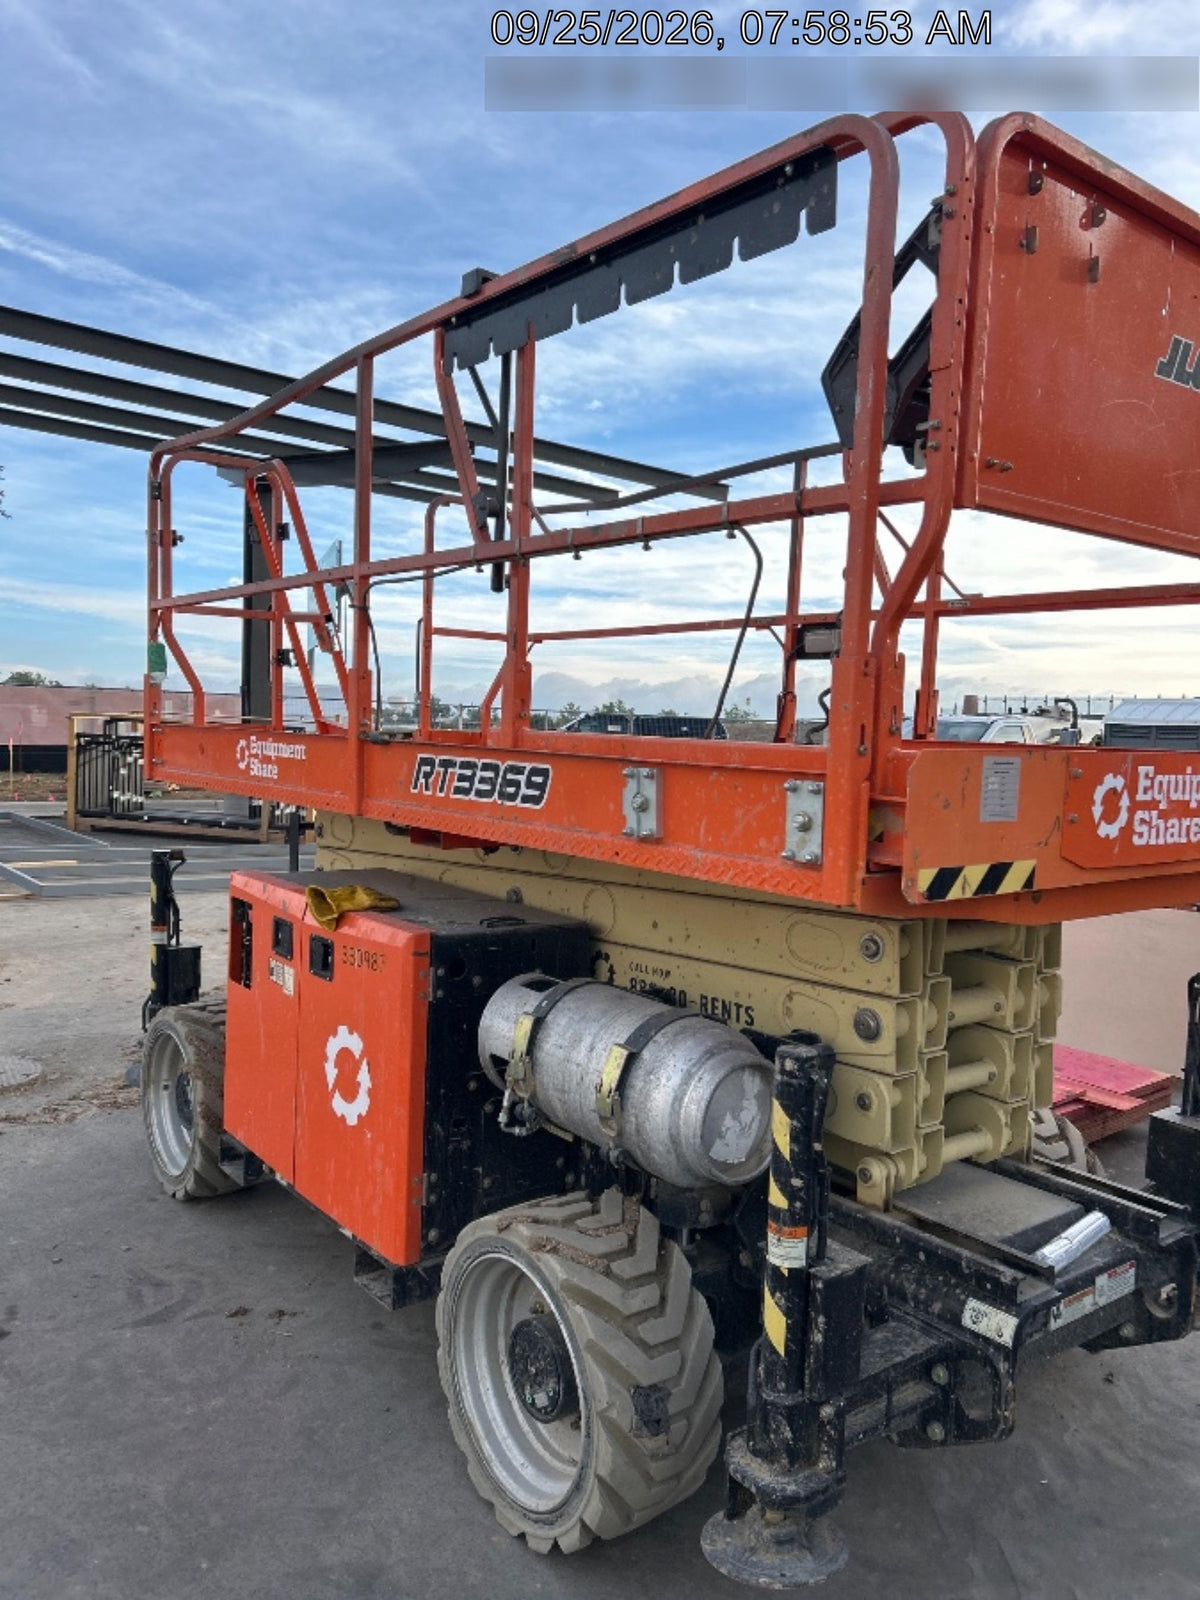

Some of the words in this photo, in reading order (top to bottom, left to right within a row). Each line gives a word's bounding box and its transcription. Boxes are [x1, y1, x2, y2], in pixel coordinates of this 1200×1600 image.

[250, 735, 306, 760] Equipment
[250, 757, 278, 779] Share
[410, 753, 552, 810] RT3369
[1132, 809, 1200, 846] Share
